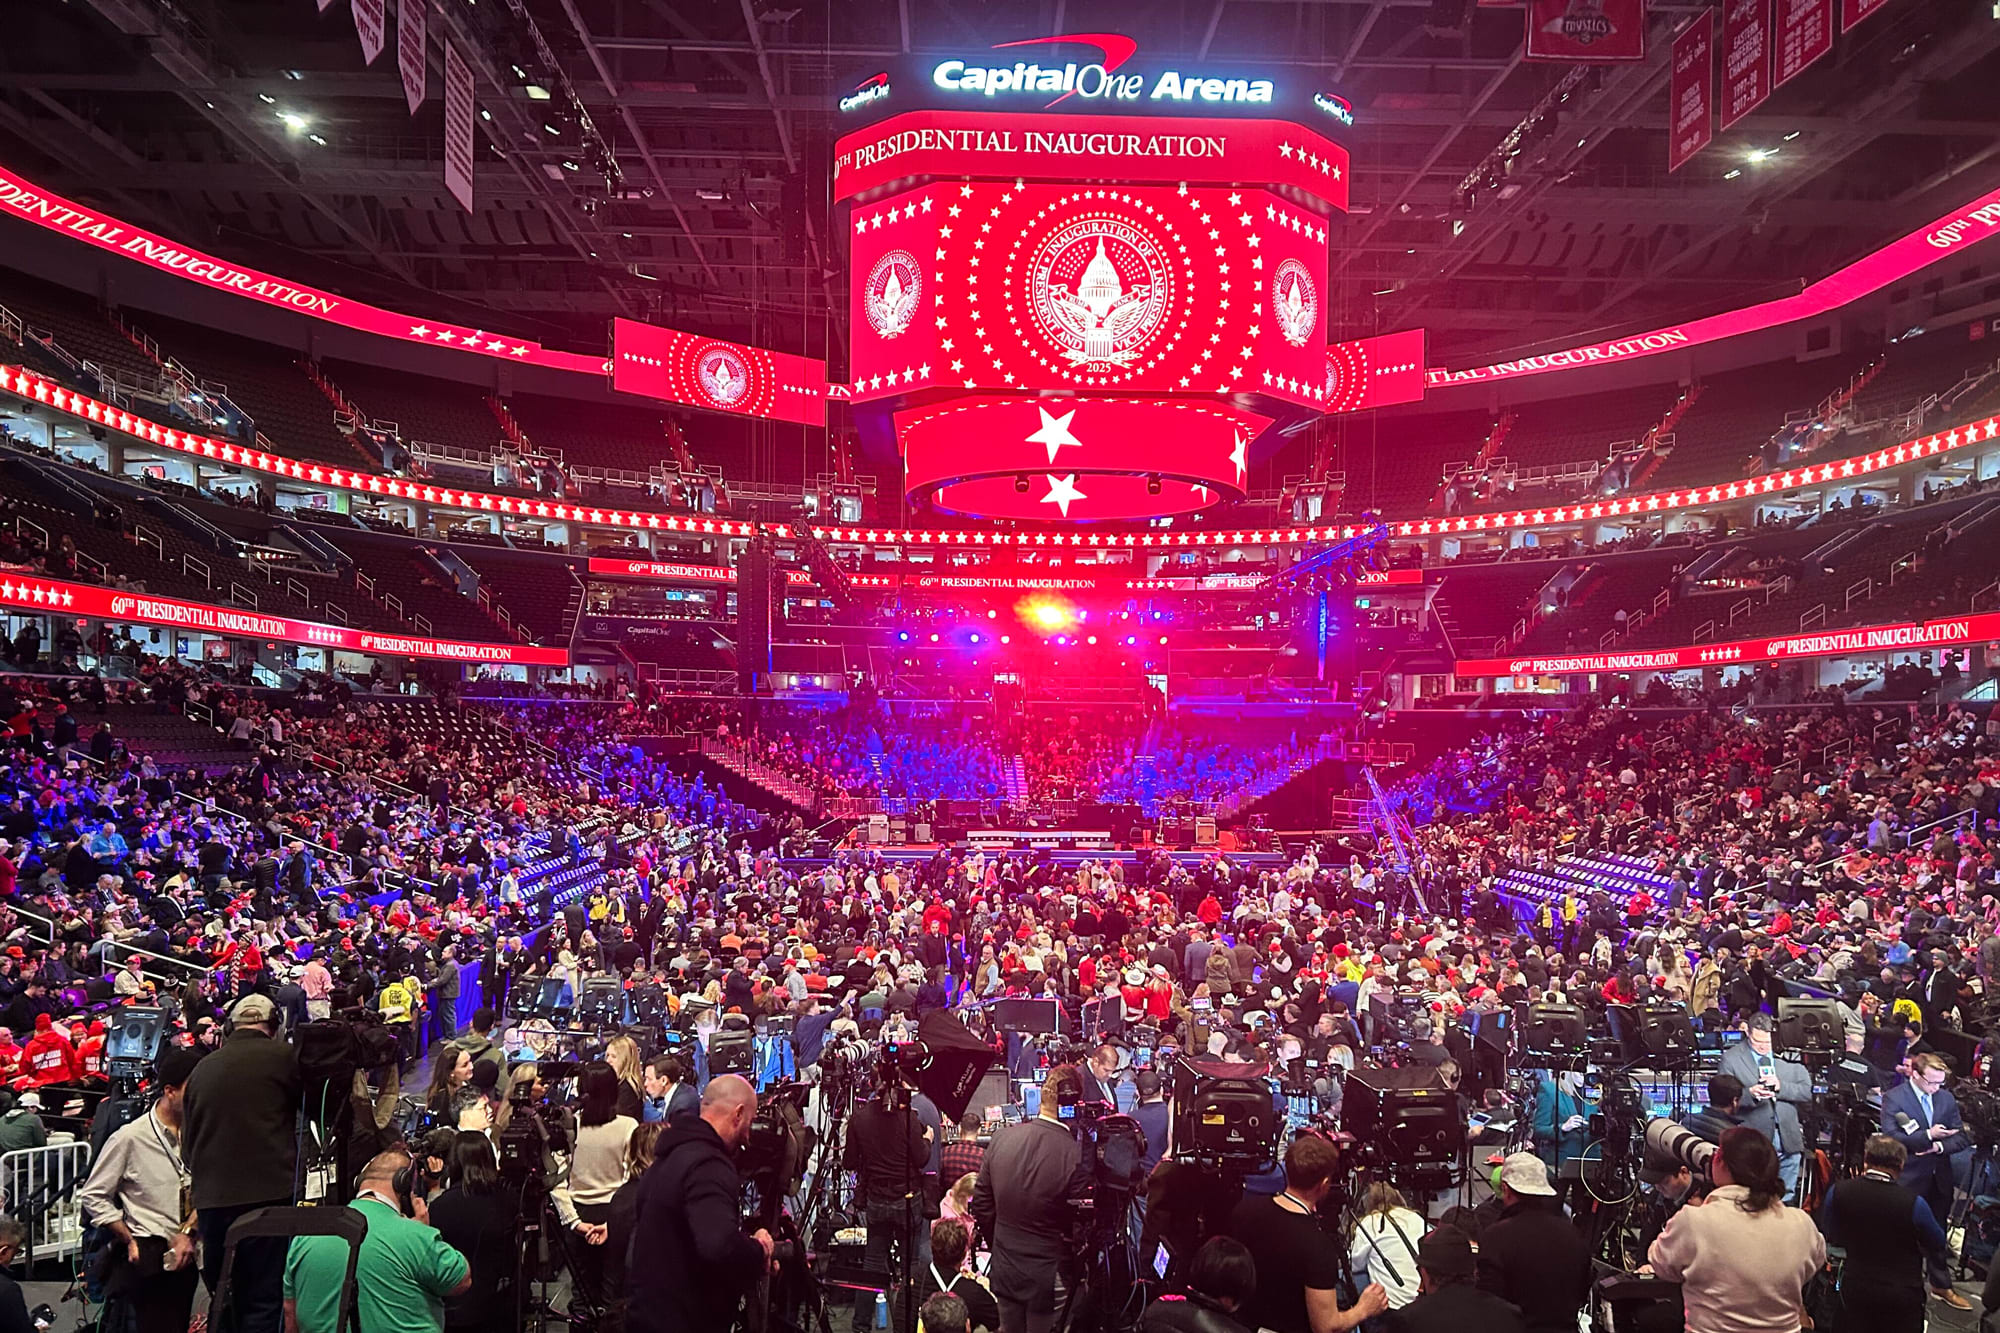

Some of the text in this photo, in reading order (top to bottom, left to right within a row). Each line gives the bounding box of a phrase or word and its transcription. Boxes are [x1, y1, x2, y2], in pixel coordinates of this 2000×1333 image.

[1729, 43, 1762, 80] CHAMPIONS
[1151, 71, 1274, 101] Arena
[855, 129, 1017, 170] PRESIDENTIAL
[1024, 132, 1227, 159] INAUGURATION
[1047, 222, 1154, 257] INAUGURATION OF
[1927, 219, 1972, 248] 60TH
[120, 236, 341, 315] INAUGURATION
[1035, 264, 1165, 350] PRESIDENT AND VICE PRESIDENT
[1086, 362, 1112, 373] 2025
[1490, 329, 1689, 375] INAUGURATION
[628, 562, 649, 573] 60TH
[650, 565, 724, 579] PRESIDENTIAL
[920, 577, 1095, 588] 60TH PRESIDENTIAL INAUGURATION
[1205, 579, 1225, 588] 60TH
[111, 595, 286, 636] 60TH PRESIDENTIAL INAUGURATION
[373, 637, 435, 655] PRESIDENTIAL
[436, 644, 511, 659] INAUGURATION
[1767, 622, 1969, 656] 60TH PRESIDENTIAL INAUGURATION
[1510, 652, 1679, 673] 60TH PRESIDENTIAL INAUGURATION
